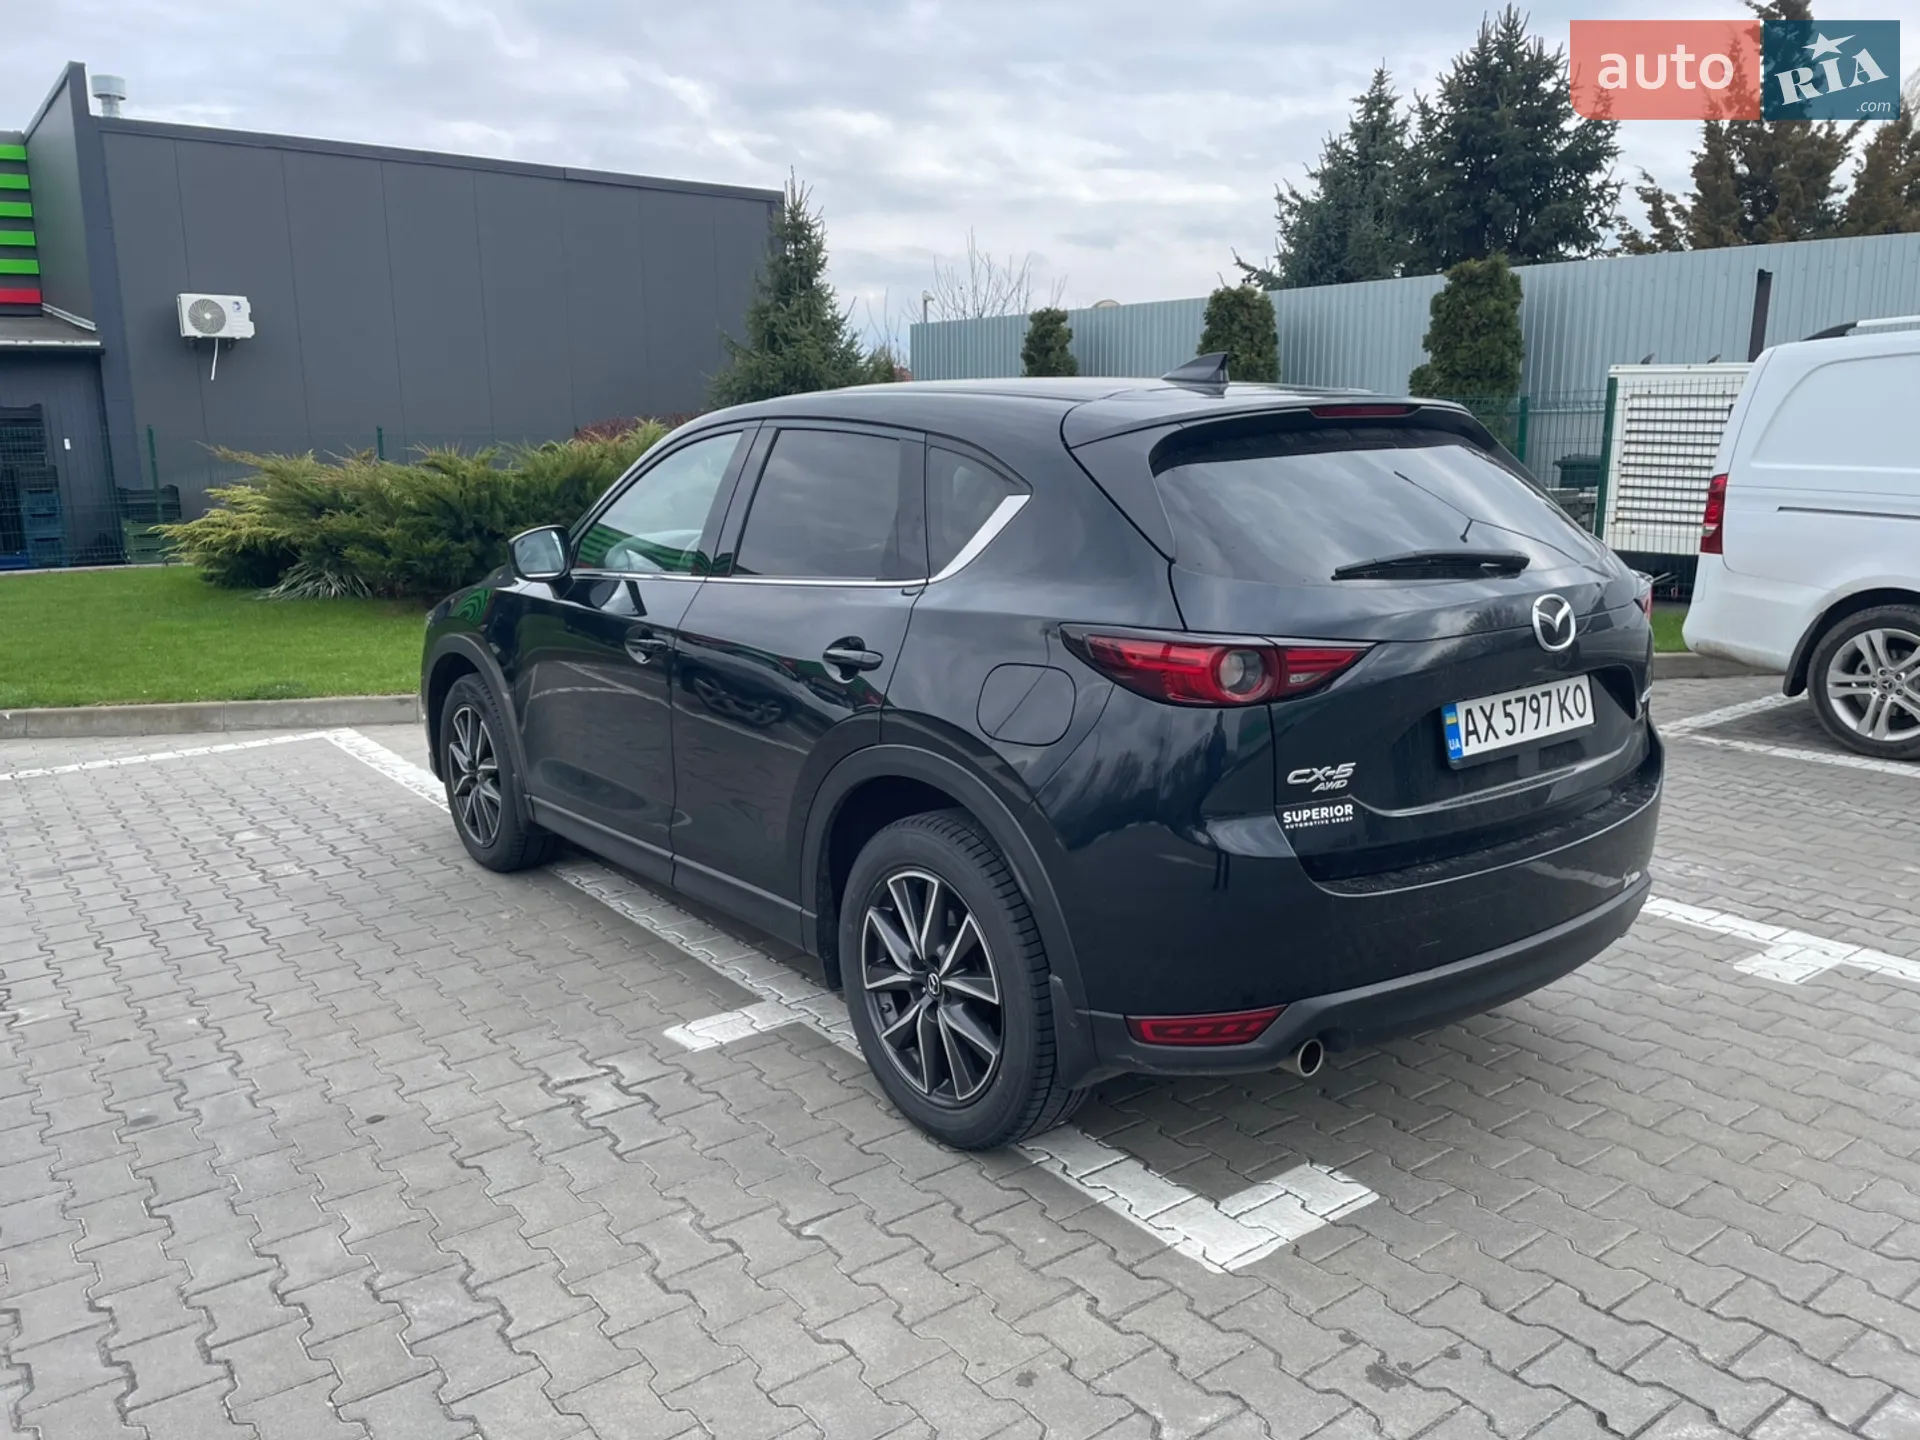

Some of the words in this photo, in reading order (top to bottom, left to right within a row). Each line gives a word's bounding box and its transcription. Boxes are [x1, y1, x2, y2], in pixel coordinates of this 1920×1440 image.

[1465, 703, 1499, 746] AX
[1502, 690, 1552, 736] 5797
[1557, 683, 1586, 723] KO
[1448, 738, 1460, 750] UA
[1287, 762, 1357, 785] CX-5
[1311, 779, 1348, 793] AWD
[1283, 804, 1353, 823] SUPERIOR
